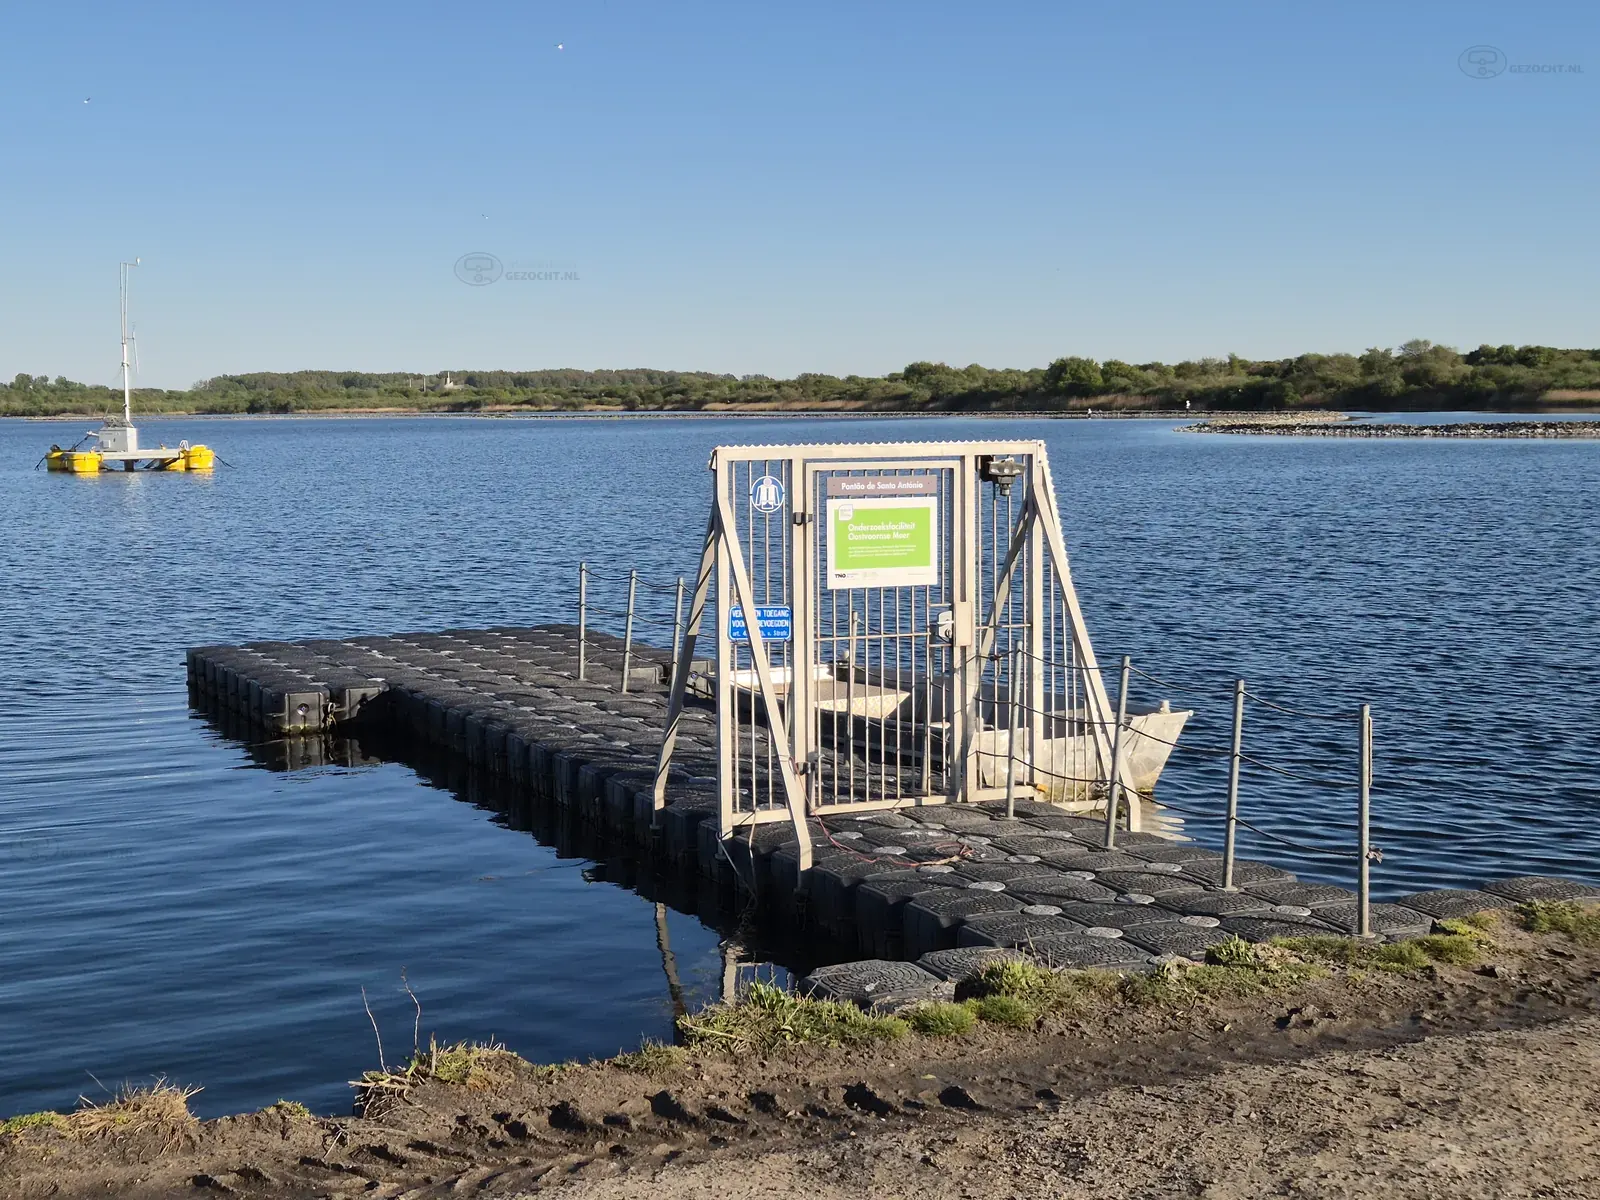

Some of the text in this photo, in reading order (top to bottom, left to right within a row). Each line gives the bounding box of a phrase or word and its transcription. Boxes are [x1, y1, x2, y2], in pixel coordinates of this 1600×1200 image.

[841, 481, 924, 490] Pontão de Santo António
[893, 532, 910, 540] Meer
[763, 609, 790, 618] TOEGANG
